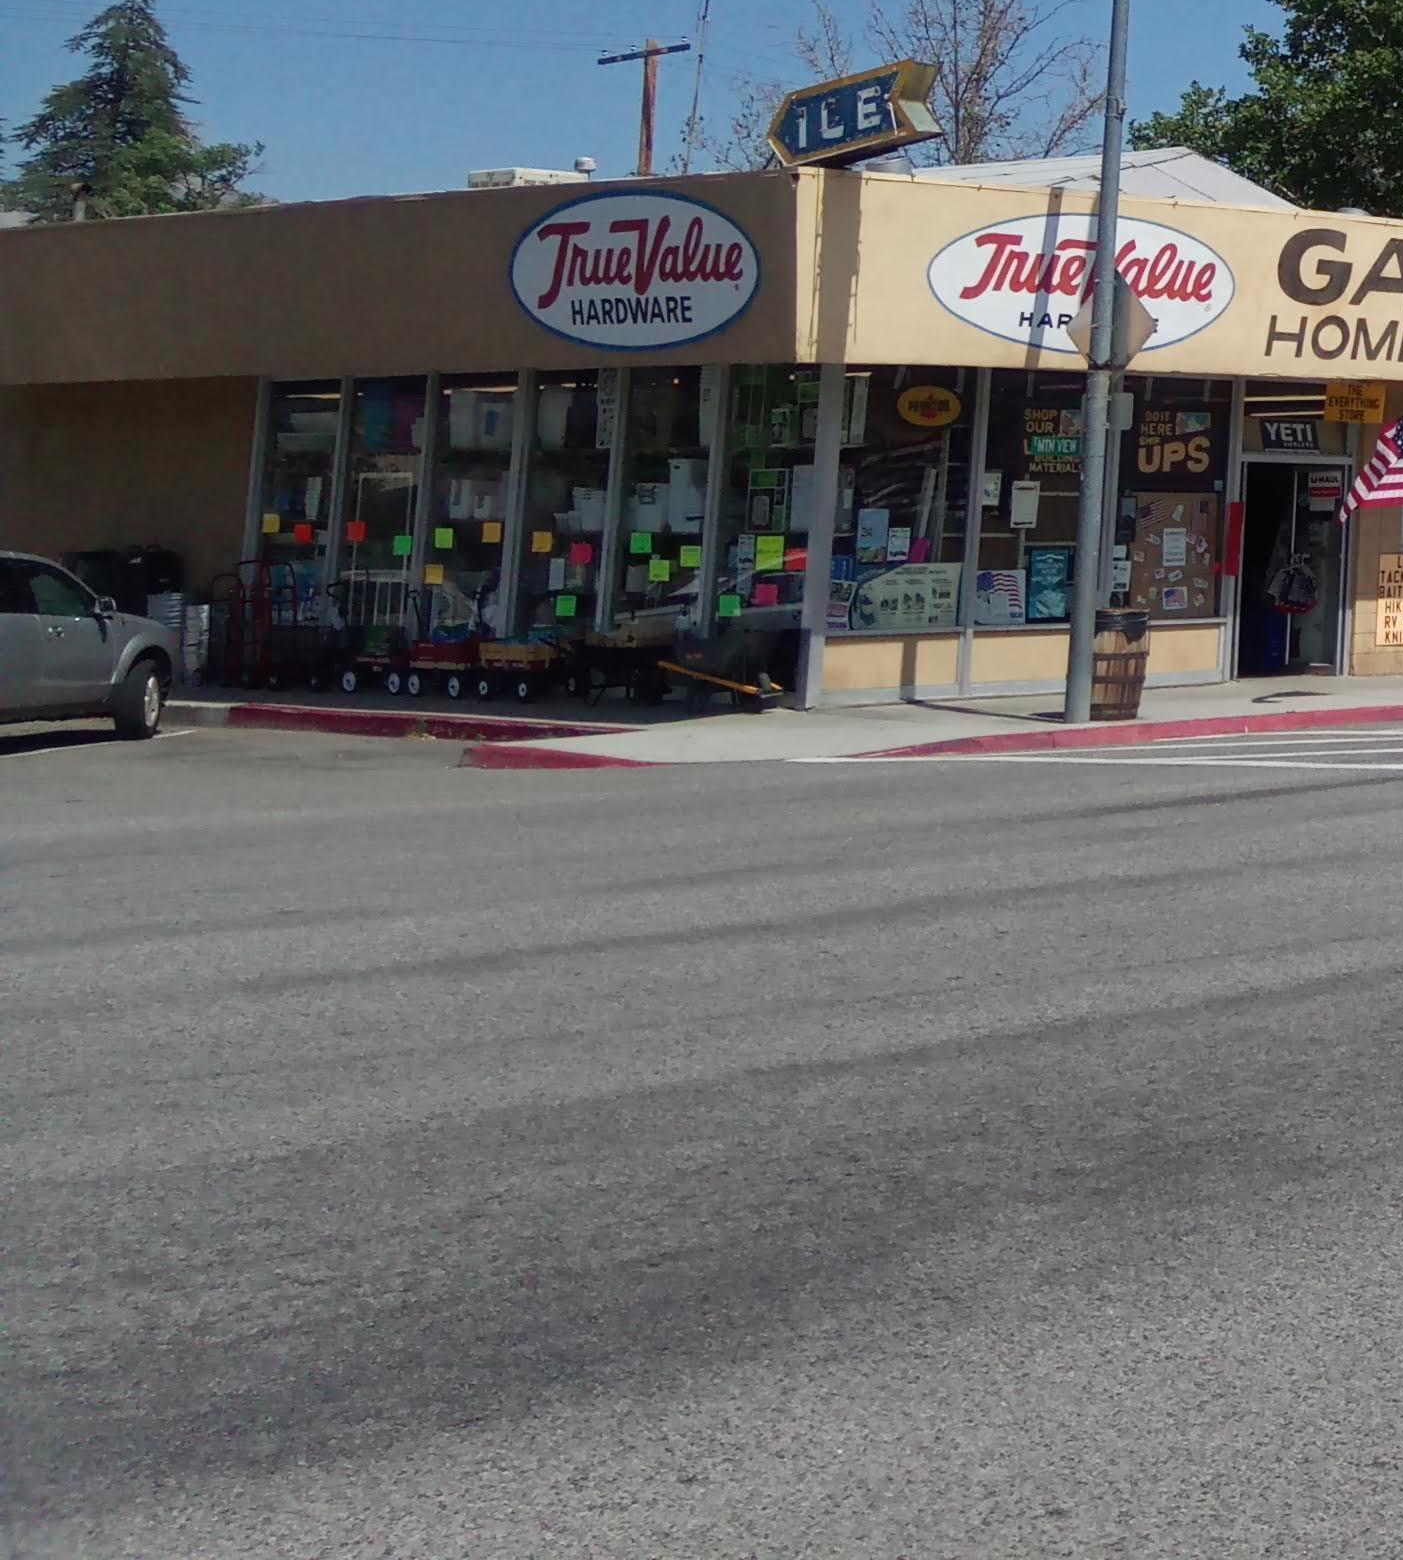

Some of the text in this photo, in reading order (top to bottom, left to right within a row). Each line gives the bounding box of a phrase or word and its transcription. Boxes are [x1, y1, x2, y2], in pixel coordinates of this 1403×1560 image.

[571, 296, 693, 325] HARDWARE
[1348, 384, 1363, 396] THE
[1328, 397, 1380, 409] EVERYTHING
[1024, 409, 1058, 422] SHOP
[1339, 410, 1366, 421] STORE
[1026, 422, 1054, 433] OUR
[1141, 423, 1173, 436] HERE
[1264, 422, 1314, 442] YETI
[1037, 438, 1055, 453] MTN
[1057, 439, 1077, 453] VIEW
[1138, 437, 1210, 473] UPS
[1380, 585, 1402, 598] BAIT
[1384, 616, 1397, 628] RV
